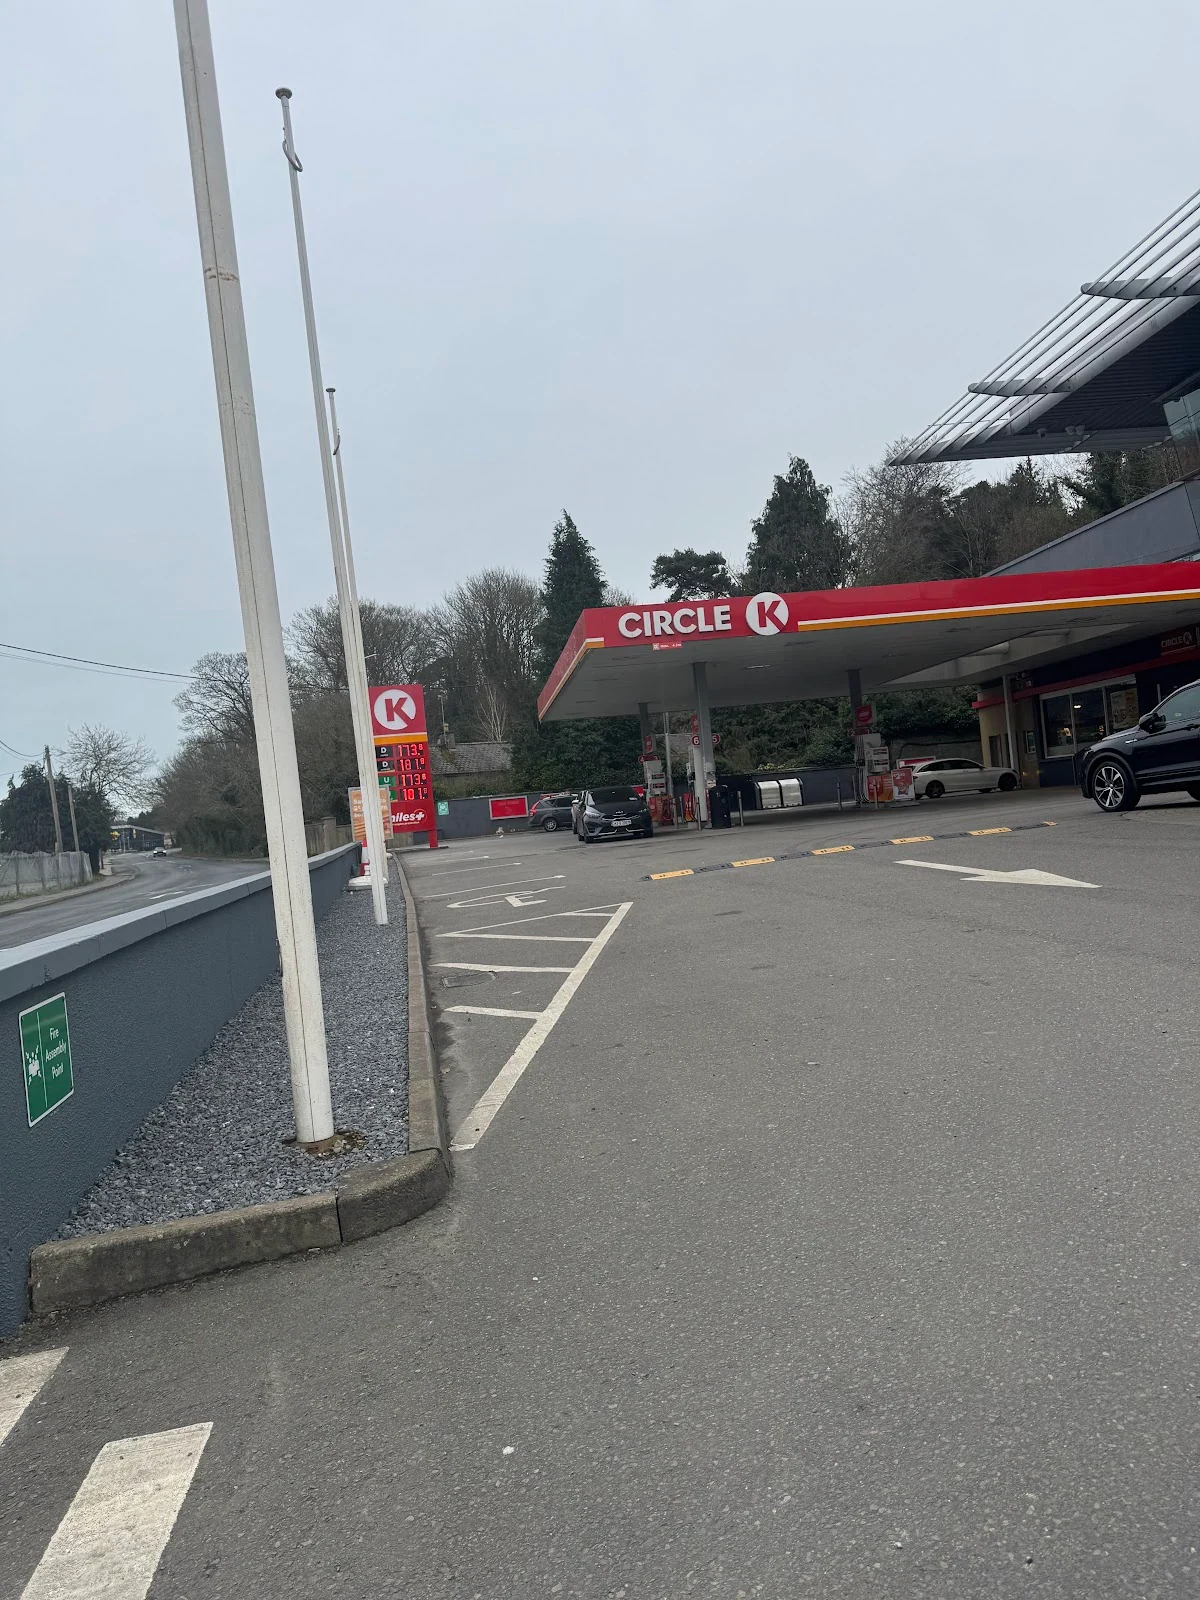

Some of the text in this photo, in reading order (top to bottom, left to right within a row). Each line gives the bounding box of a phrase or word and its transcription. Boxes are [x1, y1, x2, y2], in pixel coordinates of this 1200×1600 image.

[618, 605, 732, 639] CIRCLE
[1161, 636, 1183, 647] CIRCLE
[693, 736, 700, 745] 6
[49, 1027, 59, 1040] Fire
[45, 1039, 67, 1062] Assembly
[51, 1062, 64, 1079] Point
